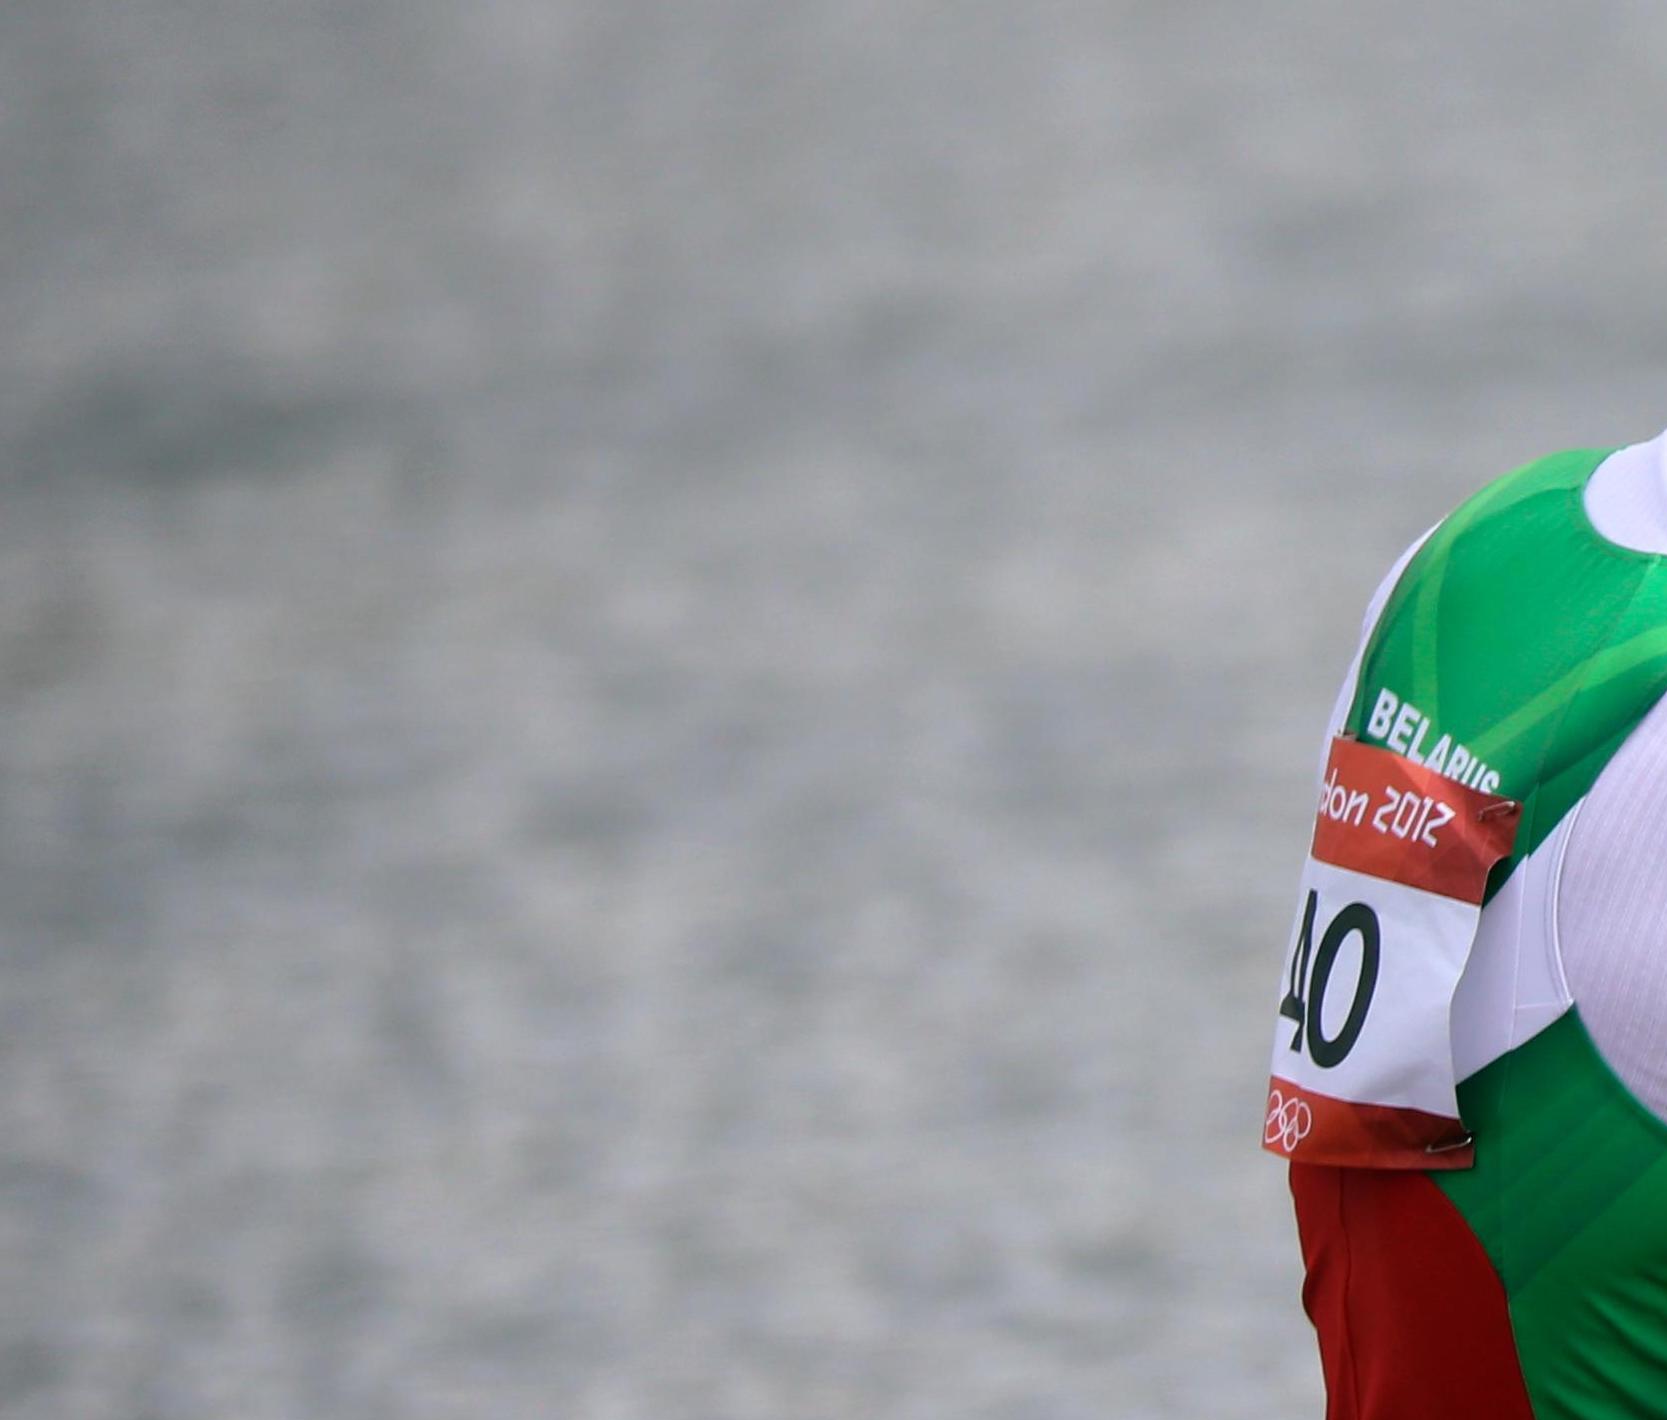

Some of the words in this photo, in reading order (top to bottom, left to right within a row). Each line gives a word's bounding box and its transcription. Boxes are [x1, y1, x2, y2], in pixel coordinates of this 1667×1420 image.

[1367, 687, 1501, 795] BELARUS
[1320, 767, 1370, 827] don
[1372, 784, 1456, 848] 2012
[1279, 889, 1381, 1069] 40
